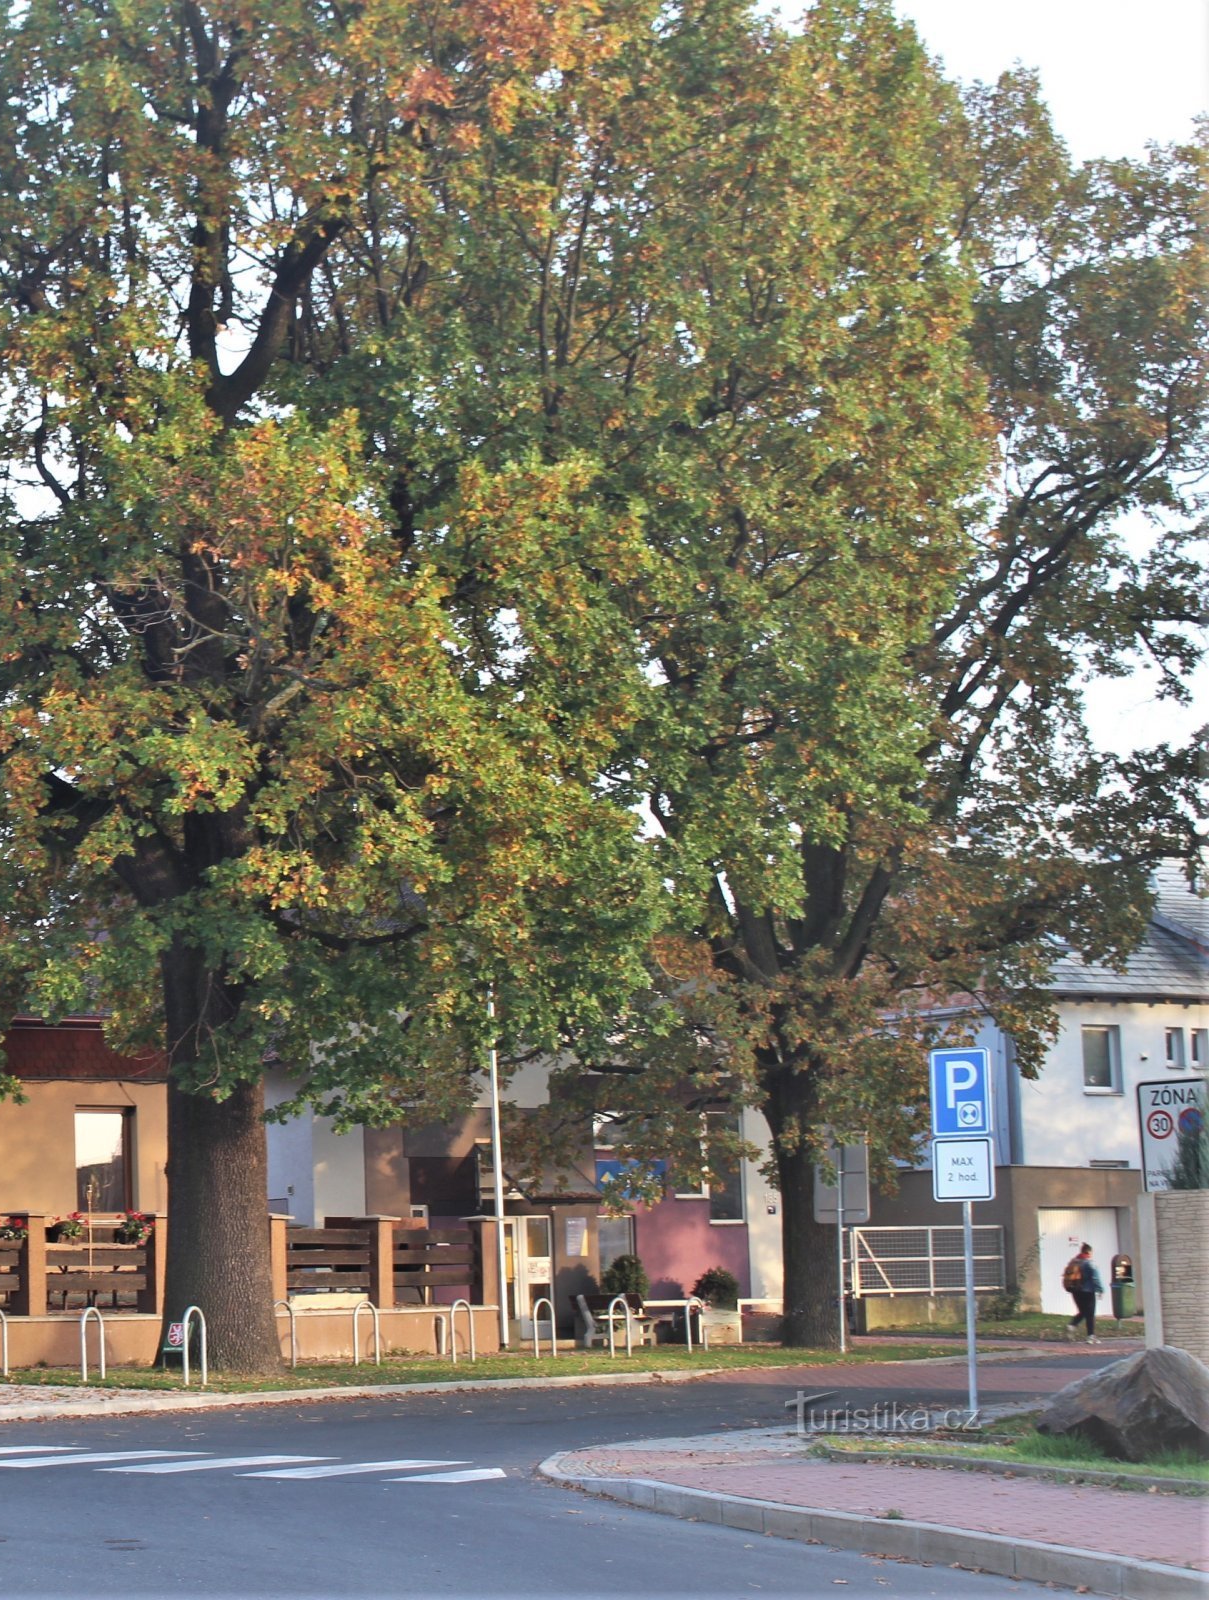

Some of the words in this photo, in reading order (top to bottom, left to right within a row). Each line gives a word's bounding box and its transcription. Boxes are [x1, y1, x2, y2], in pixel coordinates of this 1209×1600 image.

[945, 1060, 978, 1109] P
[1150, 1086, 1198, 1106] ZÓNA
[1152, 1117, 1169, 1133] 30
[952, 1156, 973, 1166] MAX
[948, 1172, 954, 1182] 2
[958, 1172, 979, 1182] hod.
